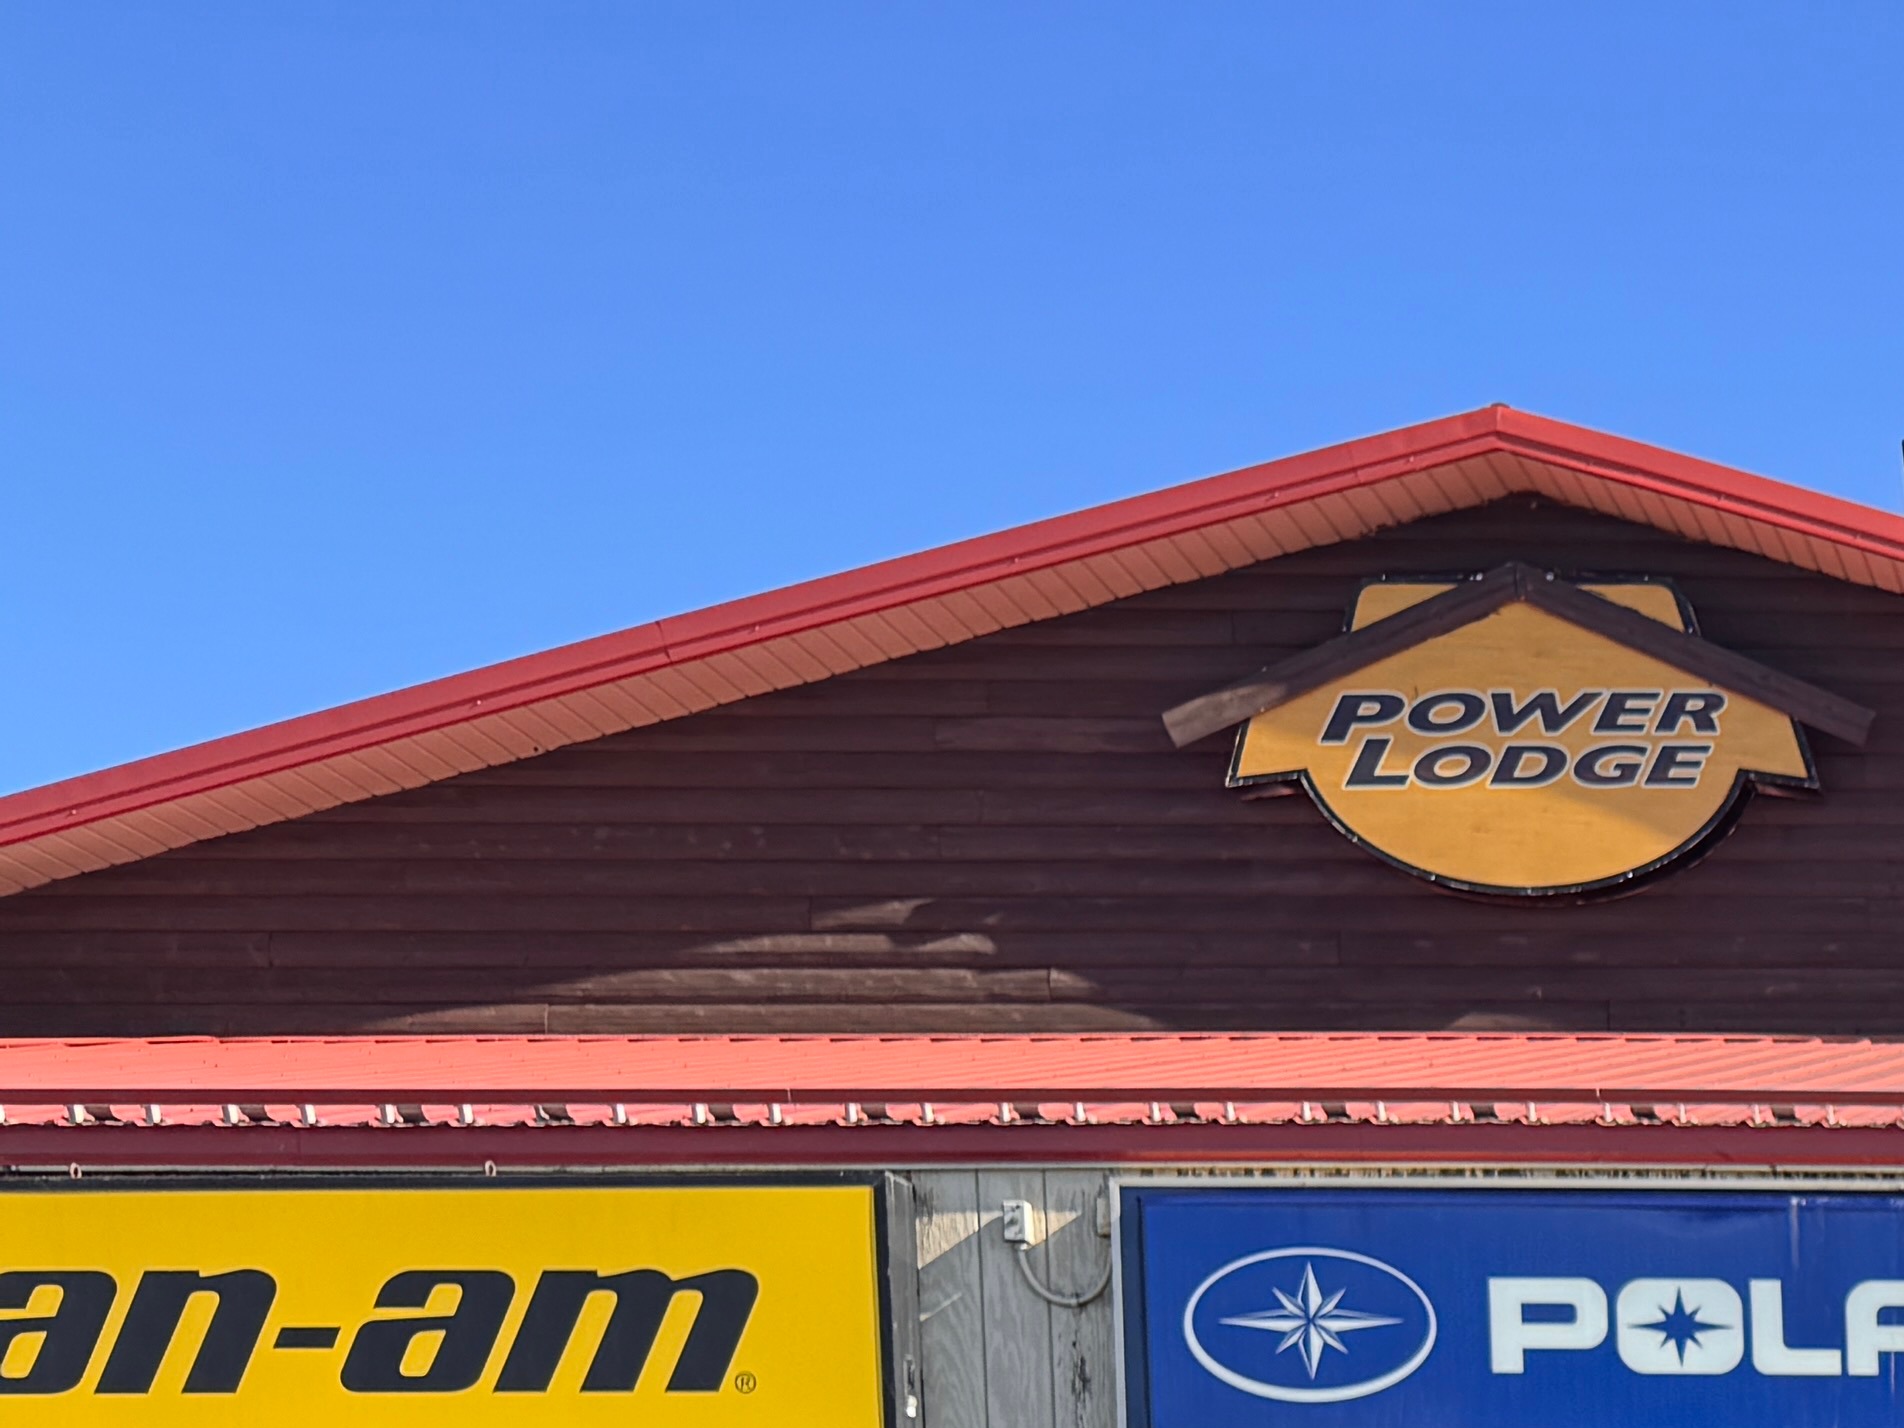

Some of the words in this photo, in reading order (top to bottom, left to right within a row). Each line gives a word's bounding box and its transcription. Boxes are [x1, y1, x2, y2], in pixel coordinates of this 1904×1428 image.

[1321, 689, 1725, 744] POWER
[1344, 738, 1712, 789] LODGE
[0, 1268, 759, 1395] an-am
